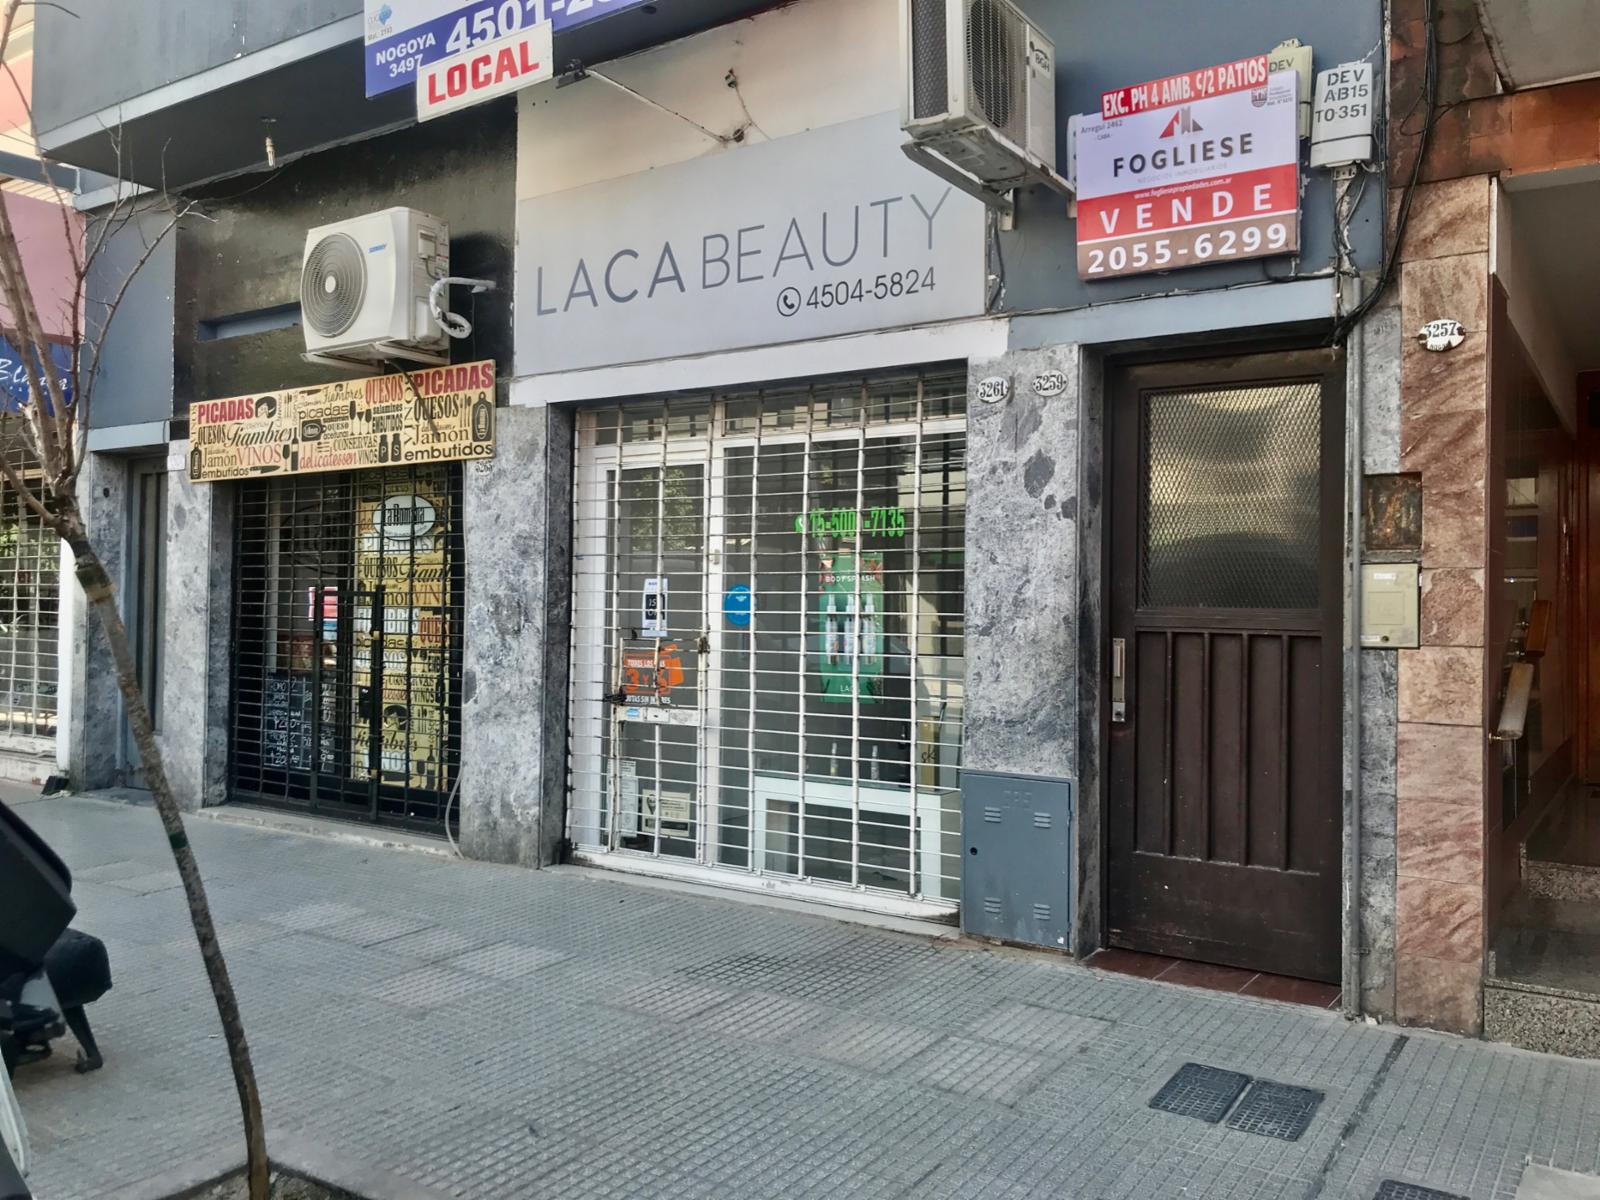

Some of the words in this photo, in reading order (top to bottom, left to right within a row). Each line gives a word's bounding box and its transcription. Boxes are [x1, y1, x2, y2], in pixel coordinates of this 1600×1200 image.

[376, 32, 436, 66] NOGOYA
[389, 54, 423, 78] 3497
[428, 40, 540, 105] LOCAL
[1269, 58, 1294, 73] DEV
[1328, 69, 1364, 86] DEV
[1103, 91, 1129, 118] EXC.
[1130, 86, 1148, 111] PH
[1151, 83, 1159, 106] 4
[1162, 76, 1194, 104] AMB.
[1218, 56, 1266, 91] PATIOS
[1113, 133, 1253, 178] FOGLIESE
[1100, 184, 1272, 234] VENDE
[537, 241, 686, 316] LACA
[701, 186, 952, 290] BEAUTY
[1087, 223, 1287, 274] 2055-6299
[806, 266, 936, 310] 4504-5824
[365, 374, 403, 406] QUESOS
[414, 363, 494, 396] PICADAS
[980, 380, 1004, 398] 3261
[1036, 374, 1063, 391] 3259
[198, 398, 254, 424] PICADAS
[298, 403, 349, 419] picadas
[414, 393, 459, 423] QUESOS
[198, 424, 226, 446] QUESOS
[224, 421, 292, 447] Fiambres
[372, 413, 403, 433] EMBUTIDOS
[413, 424, 469, 446] Jamón
[237, 444, 282, 466] VINOS
[300, 443, 357, 469] delicatessen
[358, 448, 377, 465] VINOS
[333, 435, 377, 451] CONSERVAS
[404, 442, 493, 461] embutidos
[201, 466, 250, 479] embutidos
[810, 506, 905, 538] 15-500-7135
[625, 668, 640, 692] 3
